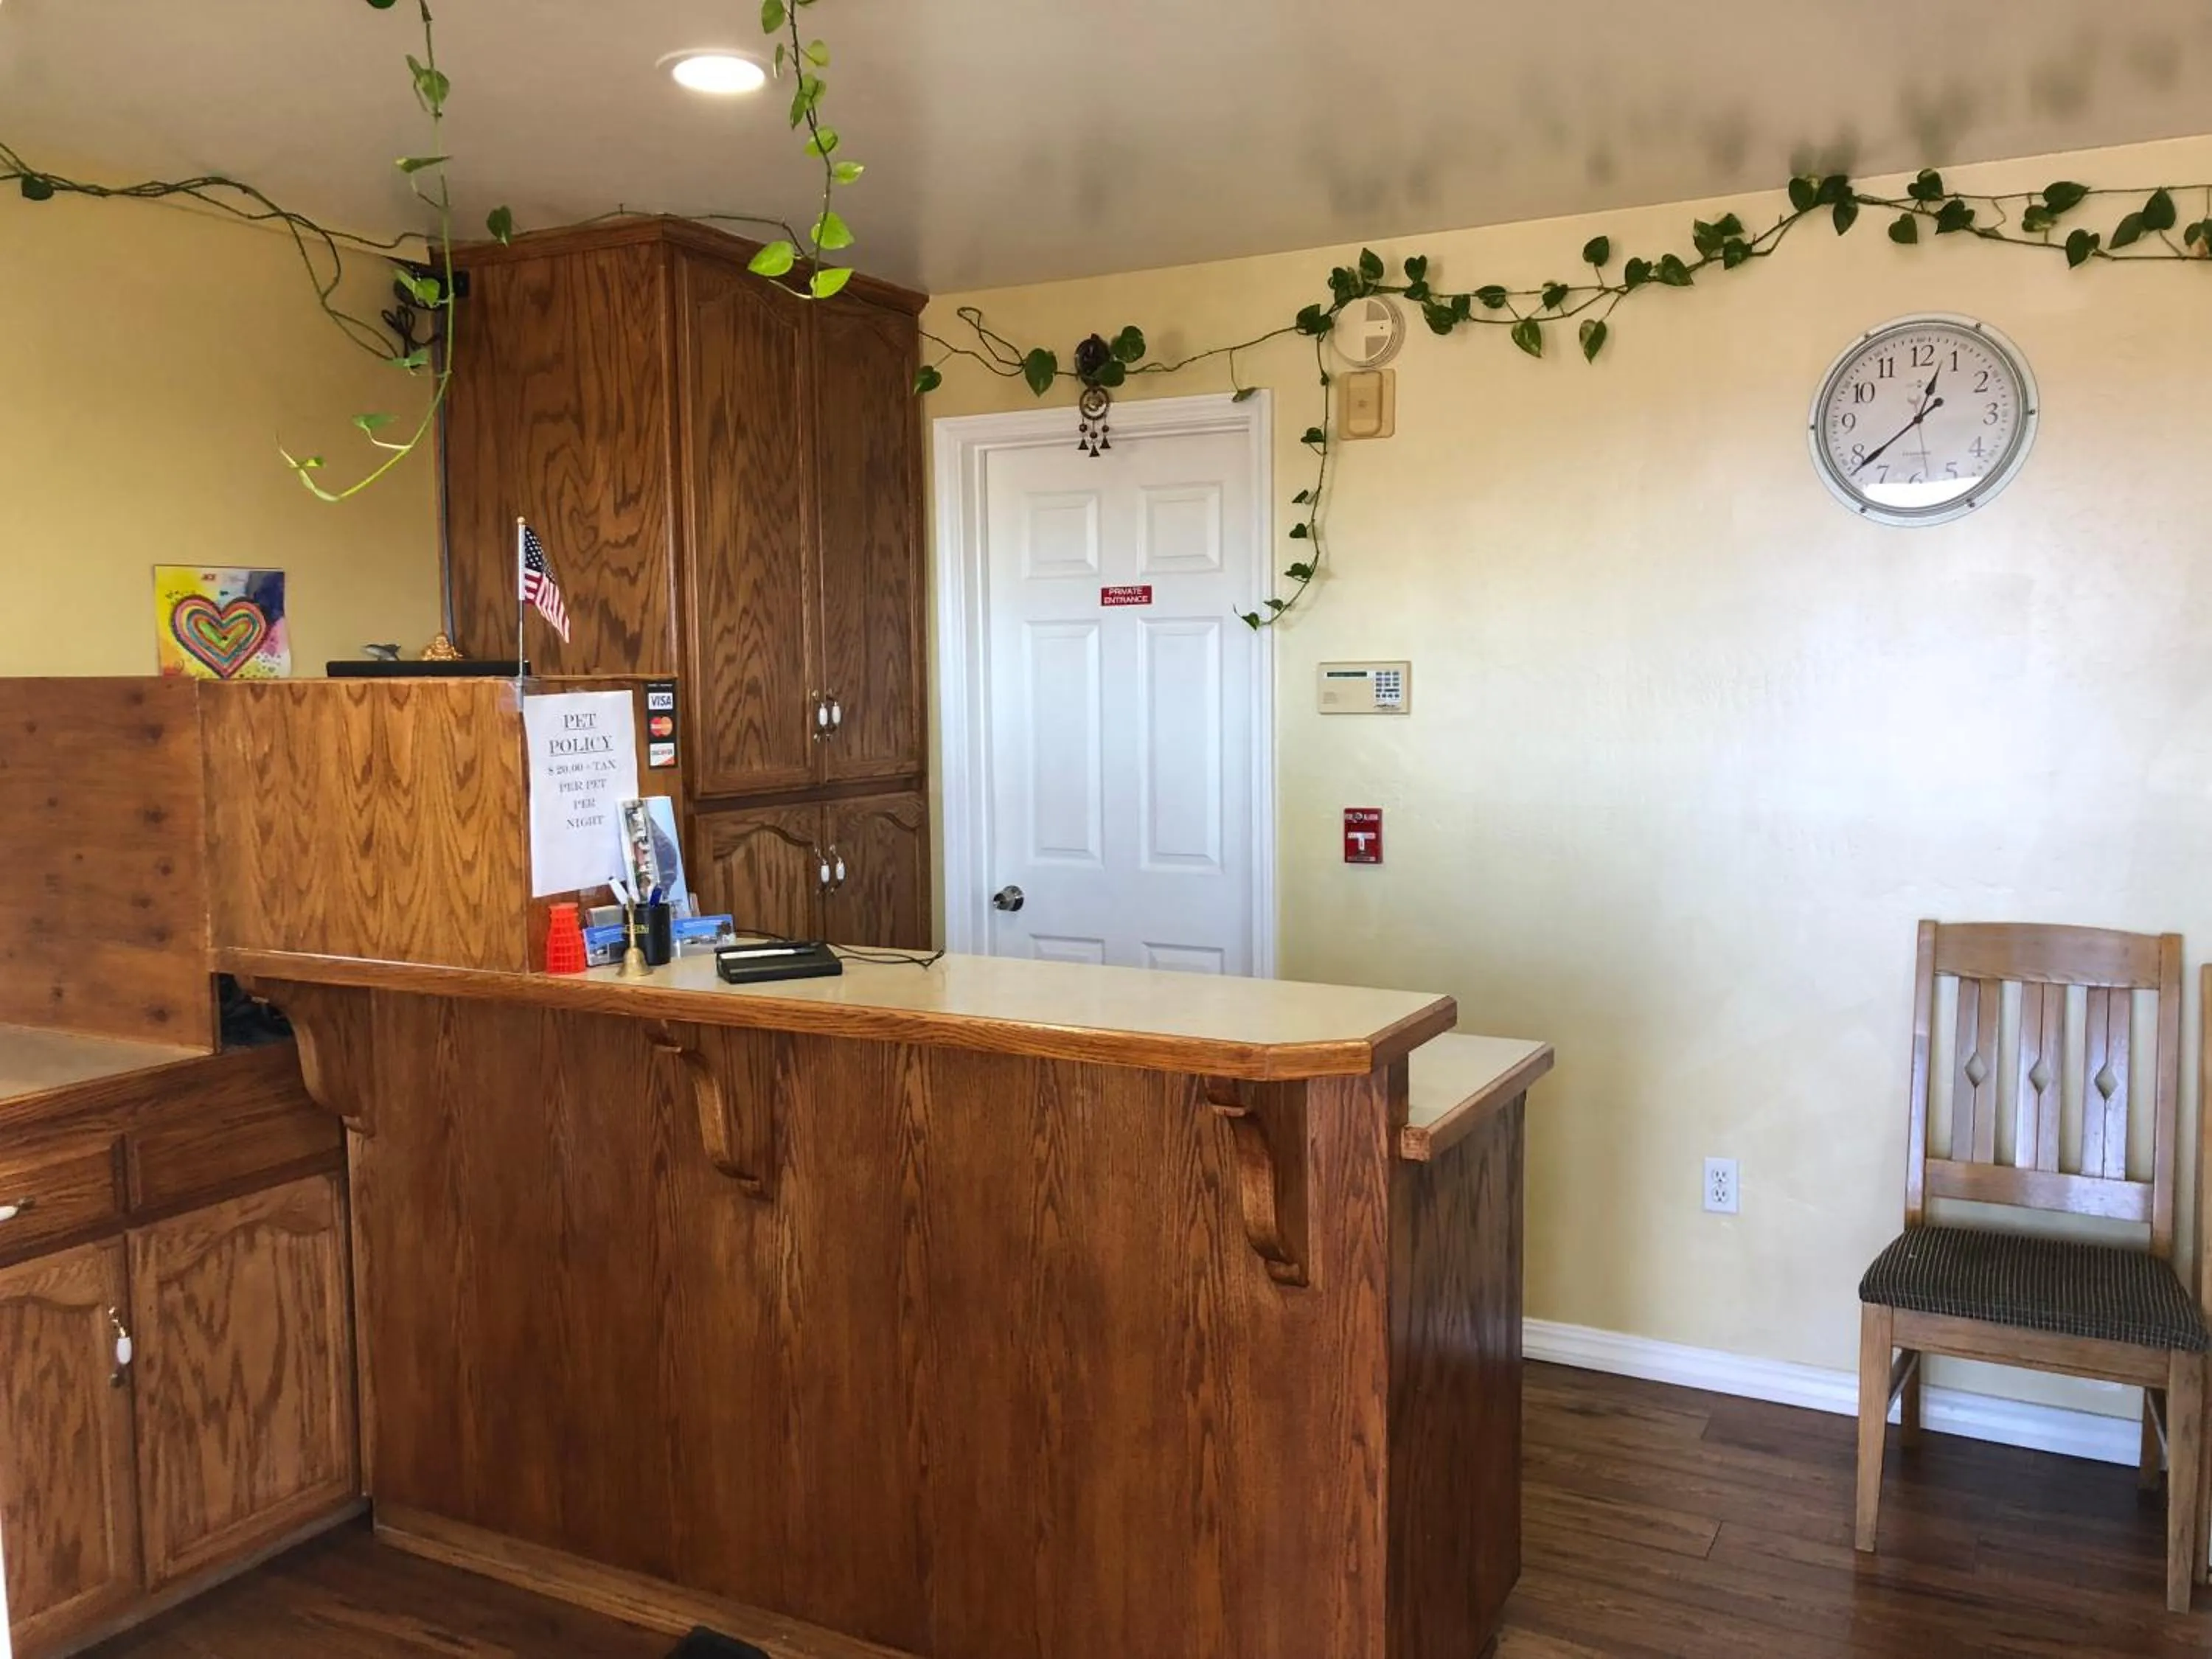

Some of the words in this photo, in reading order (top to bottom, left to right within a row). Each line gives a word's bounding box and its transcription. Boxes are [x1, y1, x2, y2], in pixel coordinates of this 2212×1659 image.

[1910, 344, 1935, 367] 12
[1950, 350, 1958, 372] 1
[1877, 357, 1894, 378] 11
[1973, 371, 1989, 393] 2
[1853, 381, 1875, 404] 10
[1841, 412, 1856, 434] 9
[1983, 403, 1998, 425] 3
[1851, 443, 1865, 465] 8
[1968, 436, 1986, 458] 4
[1876, 465, 1890, 484] 7
[1103, 596, 1148, 604] ENTRANCE
[651, 696, 671, 706] VISA
[563, 713, 597, 728] PET
[549, 735, 613, 754] POLICY
[557, 763, 583, 775] 20.00
[592, 759, 616, 771] TAX
[560, 781, 583, 793] PER
[585, 778, 607, 790] PET
[574, 798, 596, 810] PER
[566, 815, 605, 829] NIGHT
